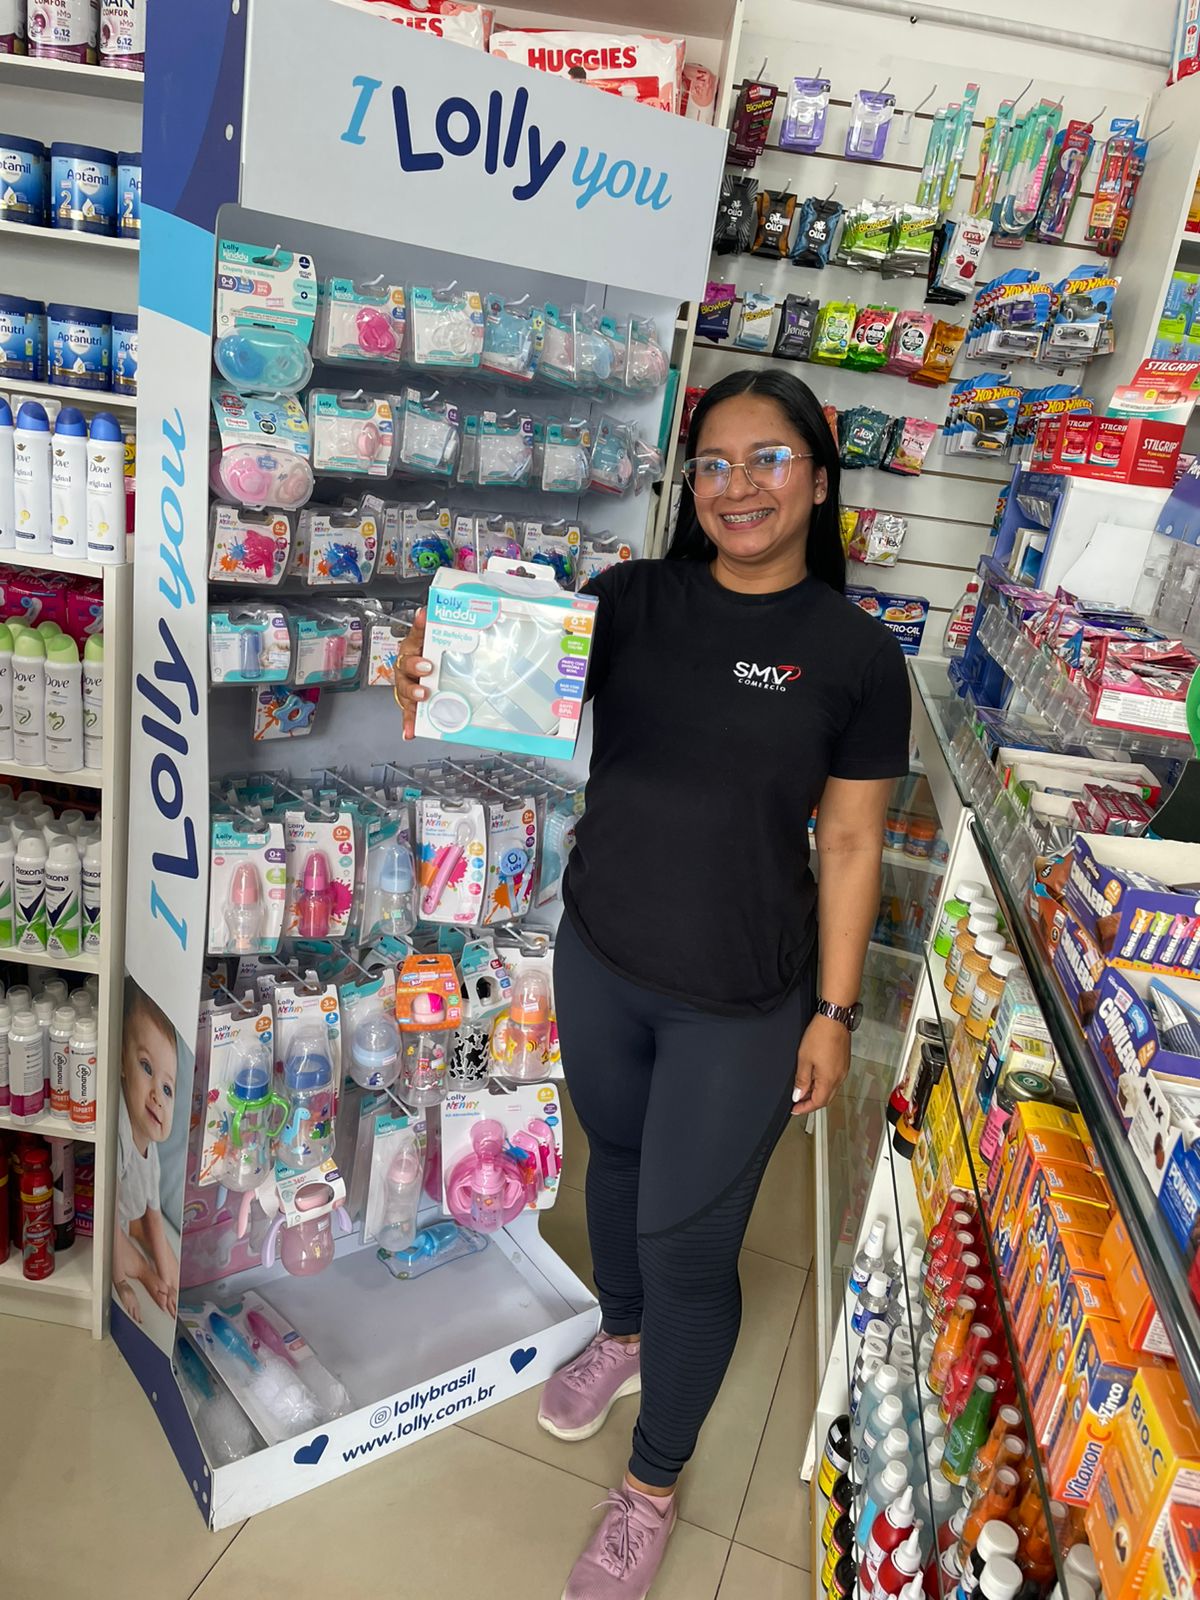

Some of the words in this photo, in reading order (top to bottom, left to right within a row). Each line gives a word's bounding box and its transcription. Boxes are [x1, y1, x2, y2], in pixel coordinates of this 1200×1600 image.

[527, 46, 639, 72] HUGGIES
[340, 75, 383, 146] I
[391, 85, 567, 201] Lolly
[571, 146, 673, 211] you
[67, 168, 109, 187] Aptamil
[61, 190, 71, 210] 2
[123, 199, 133, 218] 2
[222, 242, 240, 252] Lolly
[700, 299, 732, 315] Blowtex
[57, 331, 102, 347] Aptanutri
[1144, 361, 1199, 372] STILGRIP
[975, 389, 993, 402] HOT
[991, 387, 1021, 400] WHEELS
[1142, 438, 1179, 453] STILGRIP
[89, 463, 110, 474] Dove
[158, 407, 196, 610] you
[436, 594, 462, 609] Lolly
[434, 605, 477, 625] kinddy
[570, 616, 588, 626] 6+
[733, 661, 793, 685] SMV
[738, 678, 787, 692] COMERCIO
[135, 617, 200, 880] Lolly
[425, 812, 442, 820] Lolly
[215, 833, 233, 841] Lolly
[269, 850, 282, 858] 0+
[509, 862, 523, 874] Lolly
[151, 879, 189, 952] I
[214, 1024, 231, 1033] Lolly
[56, 1055, 65, 1085] monange
[80, 1067, 90, 1097] monange
[1169, 1161, 1198, 1220] POWER
[394, 1367, 477, 1417] lollybrasil
[341, 1384, 496, 1463] www.lolly.com.br
[1062, 1441, 1103, 1500] Vitaxon
